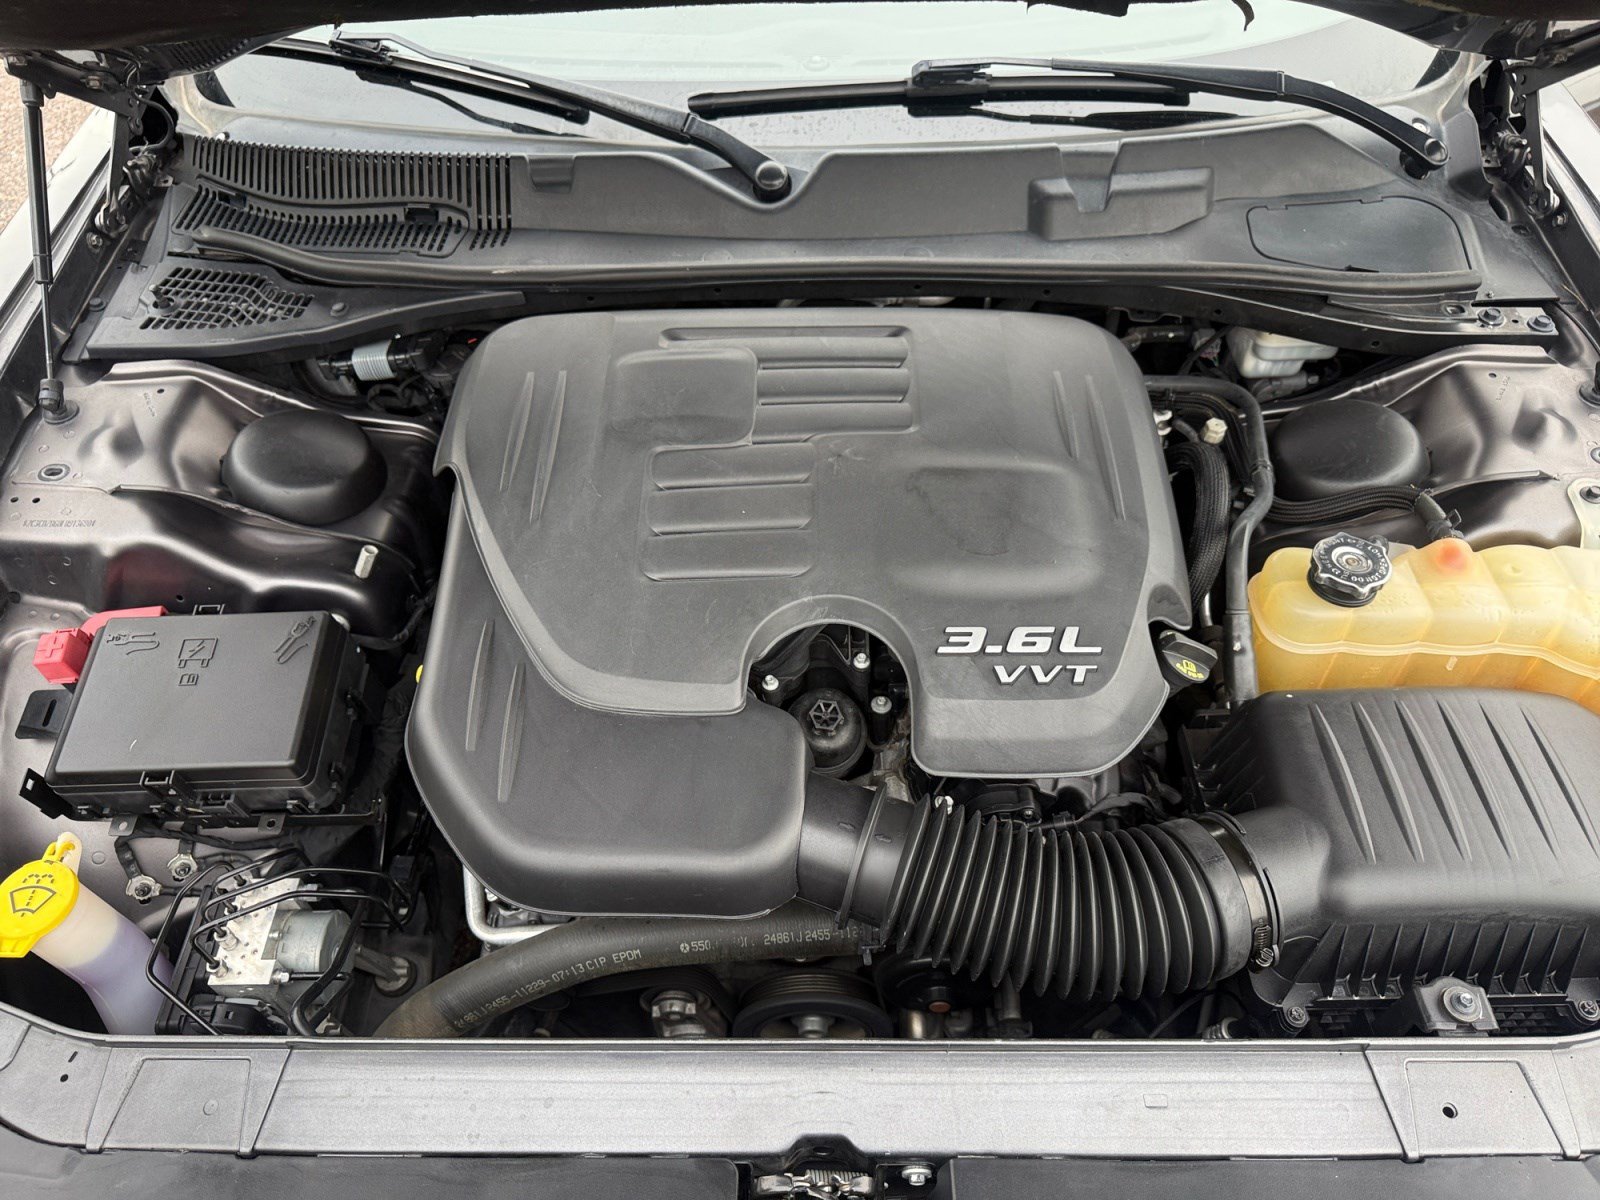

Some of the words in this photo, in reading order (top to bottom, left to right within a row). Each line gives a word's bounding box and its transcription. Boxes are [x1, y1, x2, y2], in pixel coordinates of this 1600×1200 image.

[936, 626, 1103, 655] 3.6L
[992, 664, 1098, 685] VVT
[612, 948, 642, 964] EPDM
